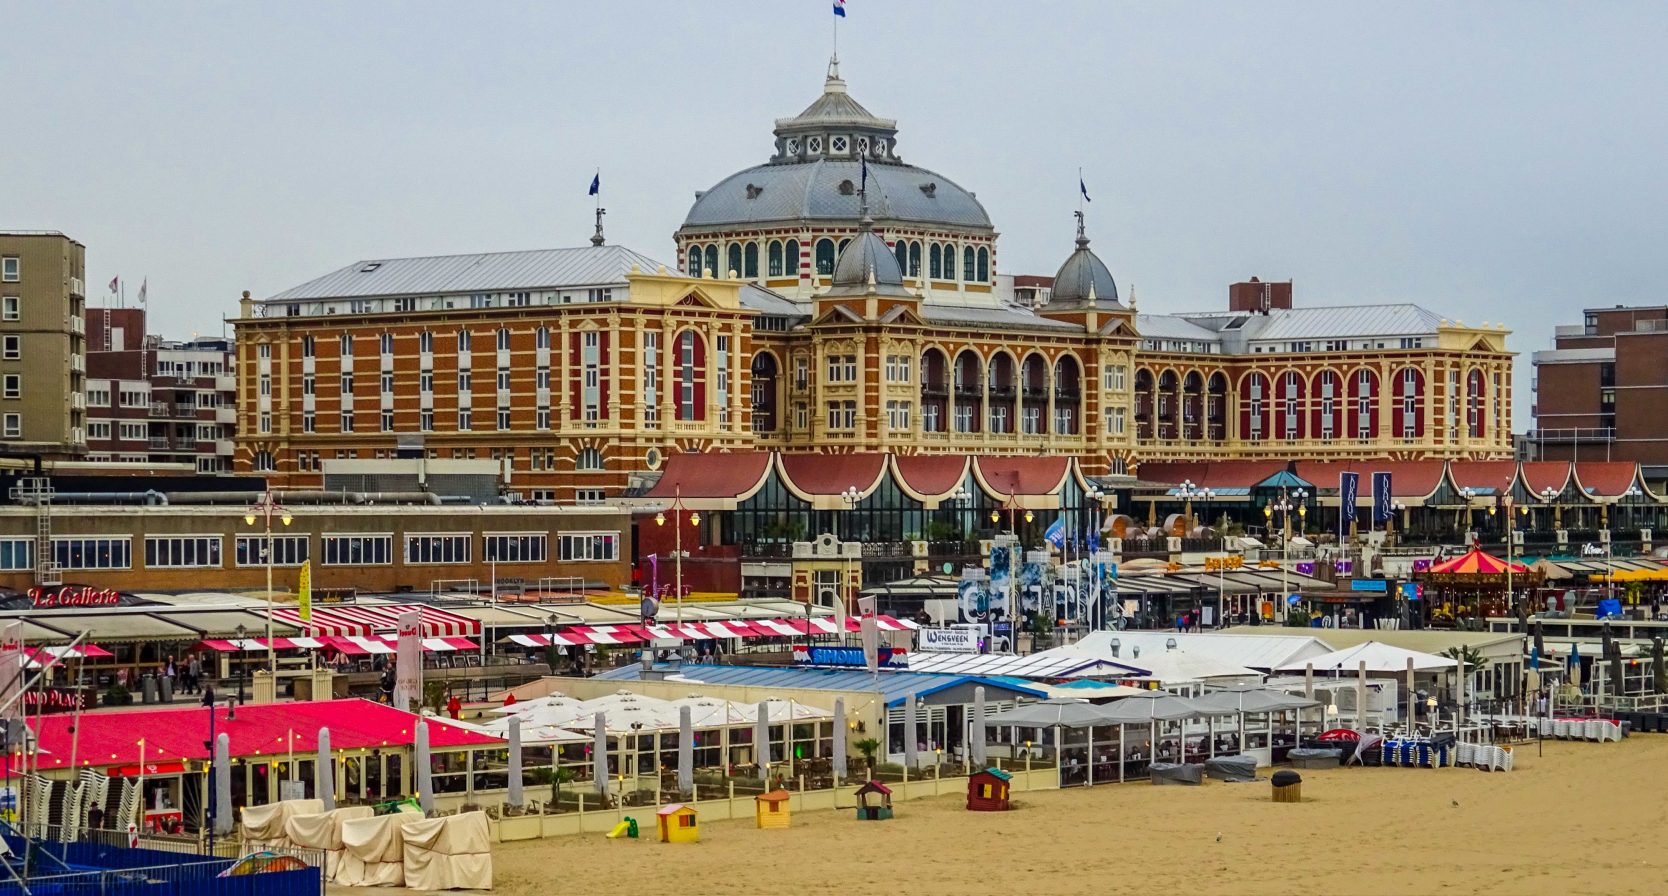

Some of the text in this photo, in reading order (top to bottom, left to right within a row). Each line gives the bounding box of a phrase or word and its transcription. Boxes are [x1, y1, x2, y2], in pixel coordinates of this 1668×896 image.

[27, 587, 57, 607] La
[927, 630, 969, 643] WENSVEEN
[813, 648, 866, 665] SIMONI
